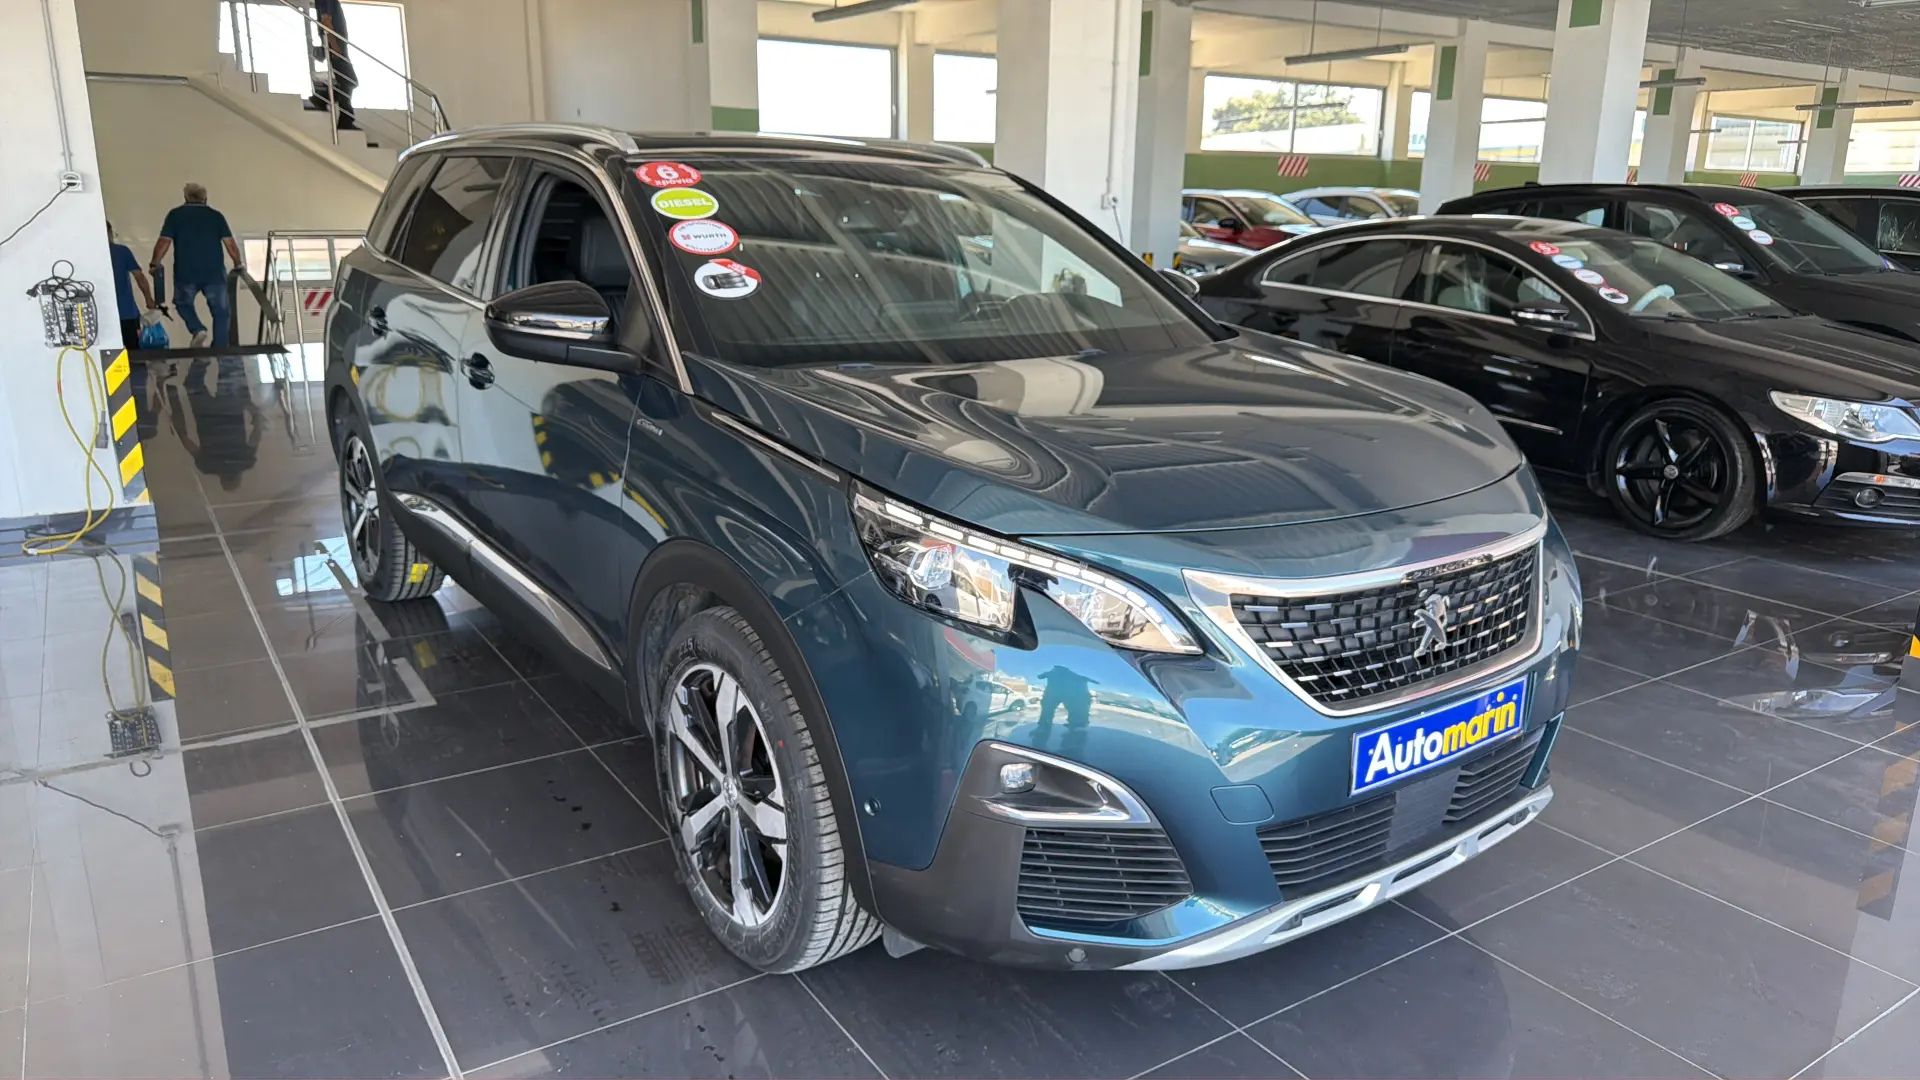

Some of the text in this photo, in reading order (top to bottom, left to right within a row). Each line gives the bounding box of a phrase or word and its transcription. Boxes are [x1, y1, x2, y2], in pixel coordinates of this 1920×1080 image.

[656, 164, 679, 180] 6
[658, 198, 713, 209] DIESEL
[1364, 691, 1517, 783] Automarin
